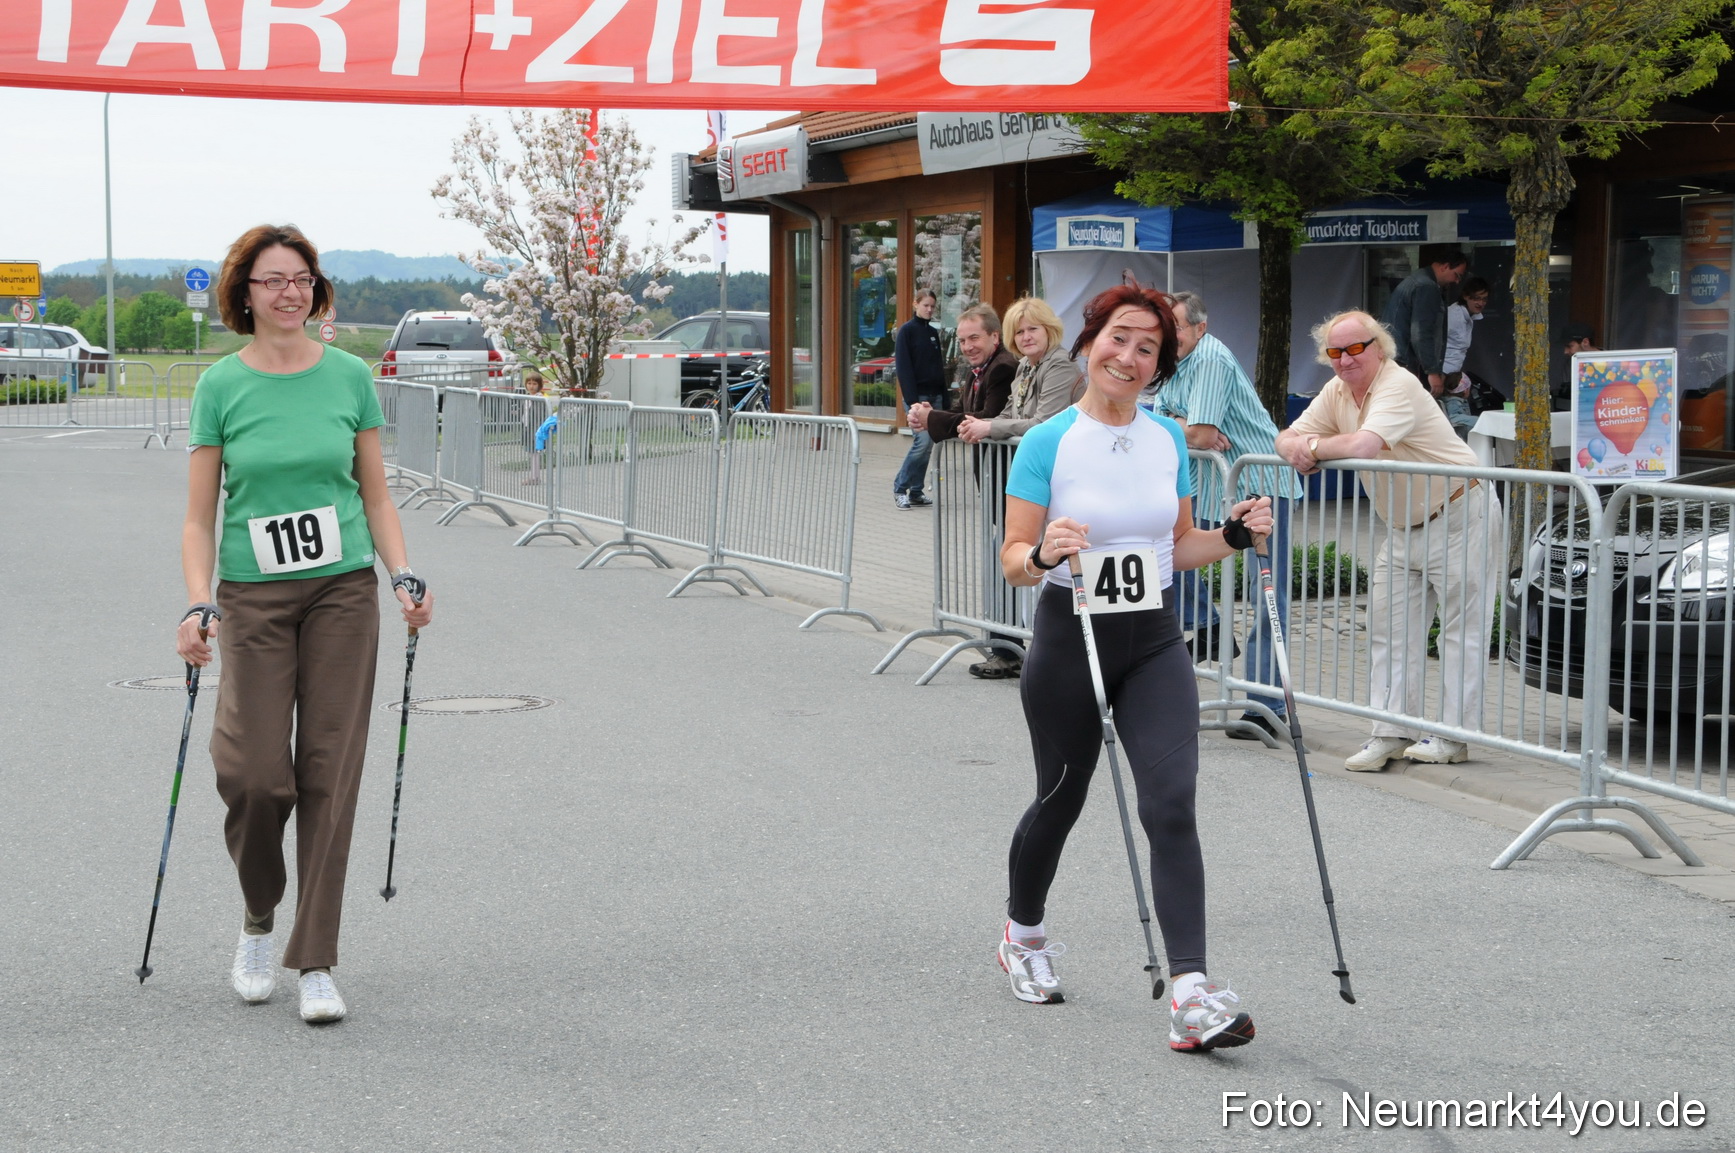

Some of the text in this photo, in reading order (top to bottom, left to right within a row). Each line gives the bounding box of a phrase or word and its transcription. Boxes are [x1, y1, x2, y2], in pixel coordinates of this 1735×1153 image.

[929, 116, 994, 150] Autohaus
[741, 148, 788, 178] SEAT
[1302, 219, 1420, 239] umarkter Tagblatt
[1691, 274, 1719, 284] WARUM
[1691, 285, 1718, 297] NICHT?
[1601, 397, 1624, 406] Hier:
[1597, 405, 1647, 419] Kinder-
[1599, 416, 1646, 427] schminken
[265, 513, 324, 566] 119
[1094, 553, 1146, 605] 49
